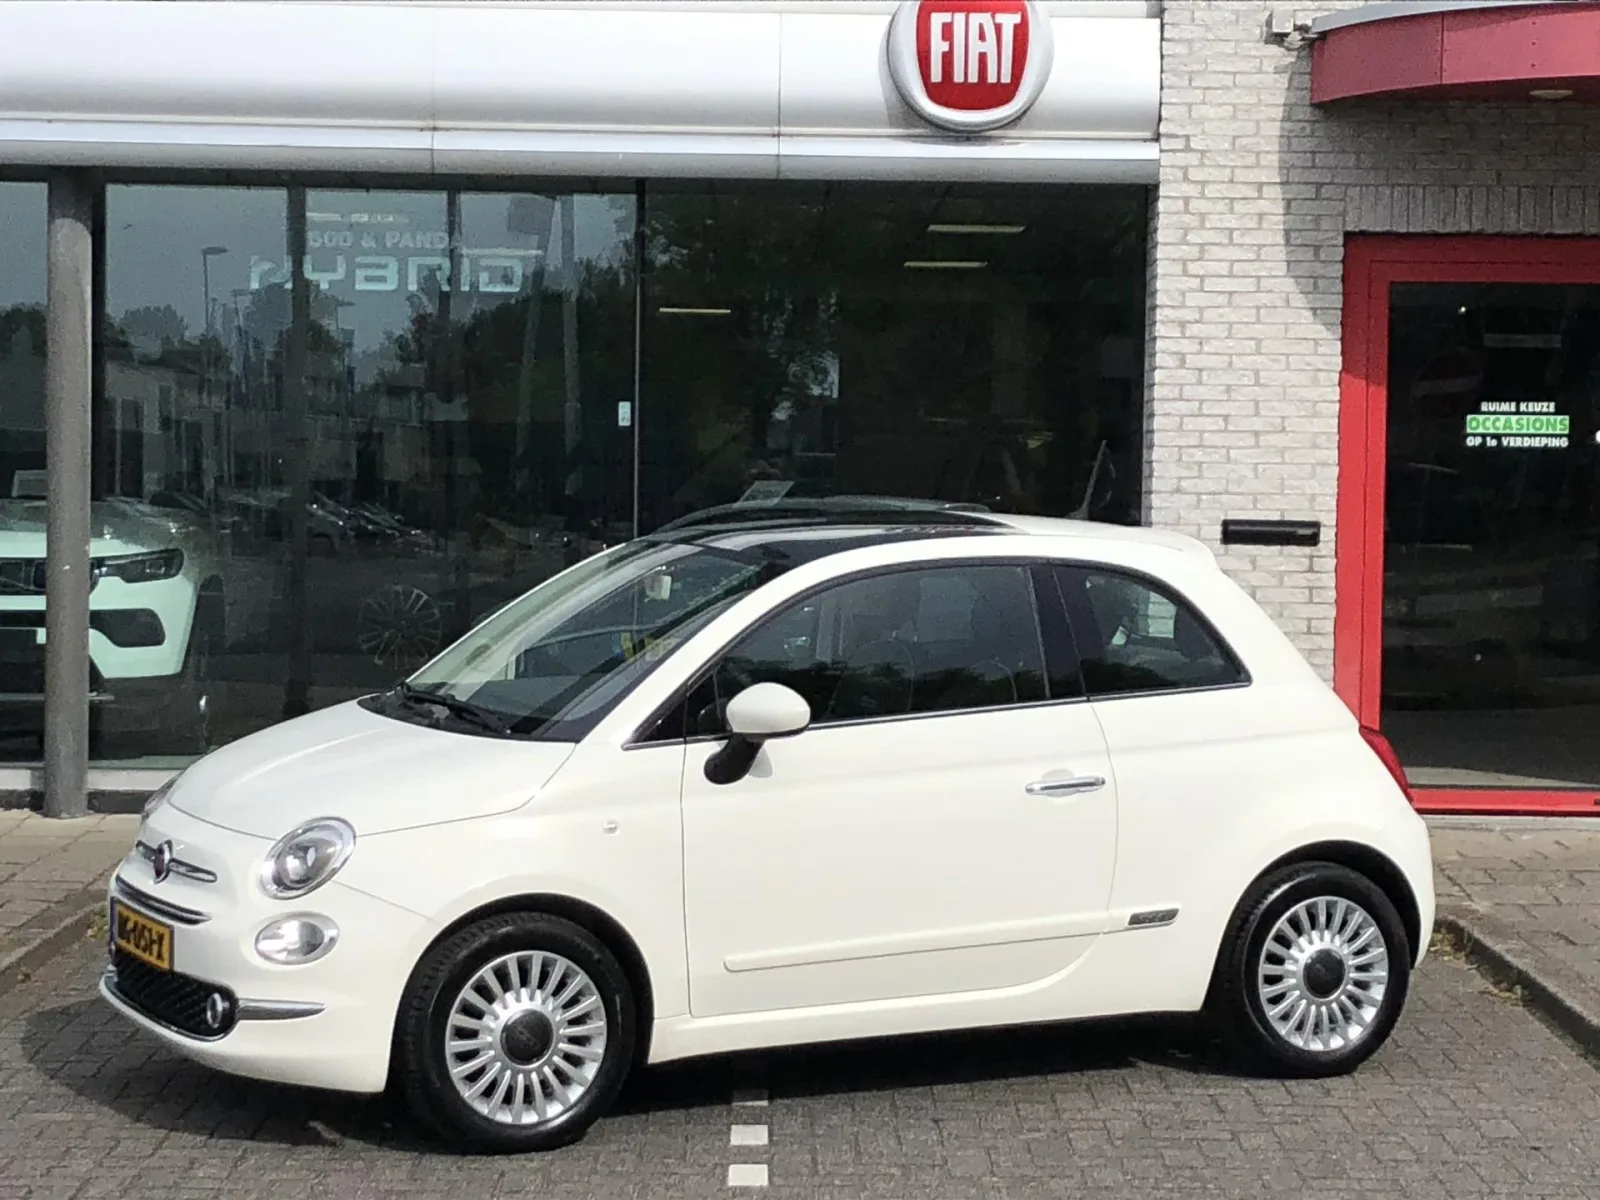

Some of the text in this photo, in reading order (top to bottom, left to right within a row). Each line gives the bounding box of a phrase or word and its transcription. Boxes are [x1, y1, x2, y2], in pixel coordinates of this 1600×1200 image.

[930, 11, 1021, 83] FIAT
[360, 230, 376, 249] &
[385, 231, 453, 250] PAND
[1481, 401, 1556, 413] RUIME KEUZE
[1468, 416, 1568, 432] OCCASIONS
[1466, 436, 1482, 447] OP
[1501, 436, 1569, 447] VERDIEPING
